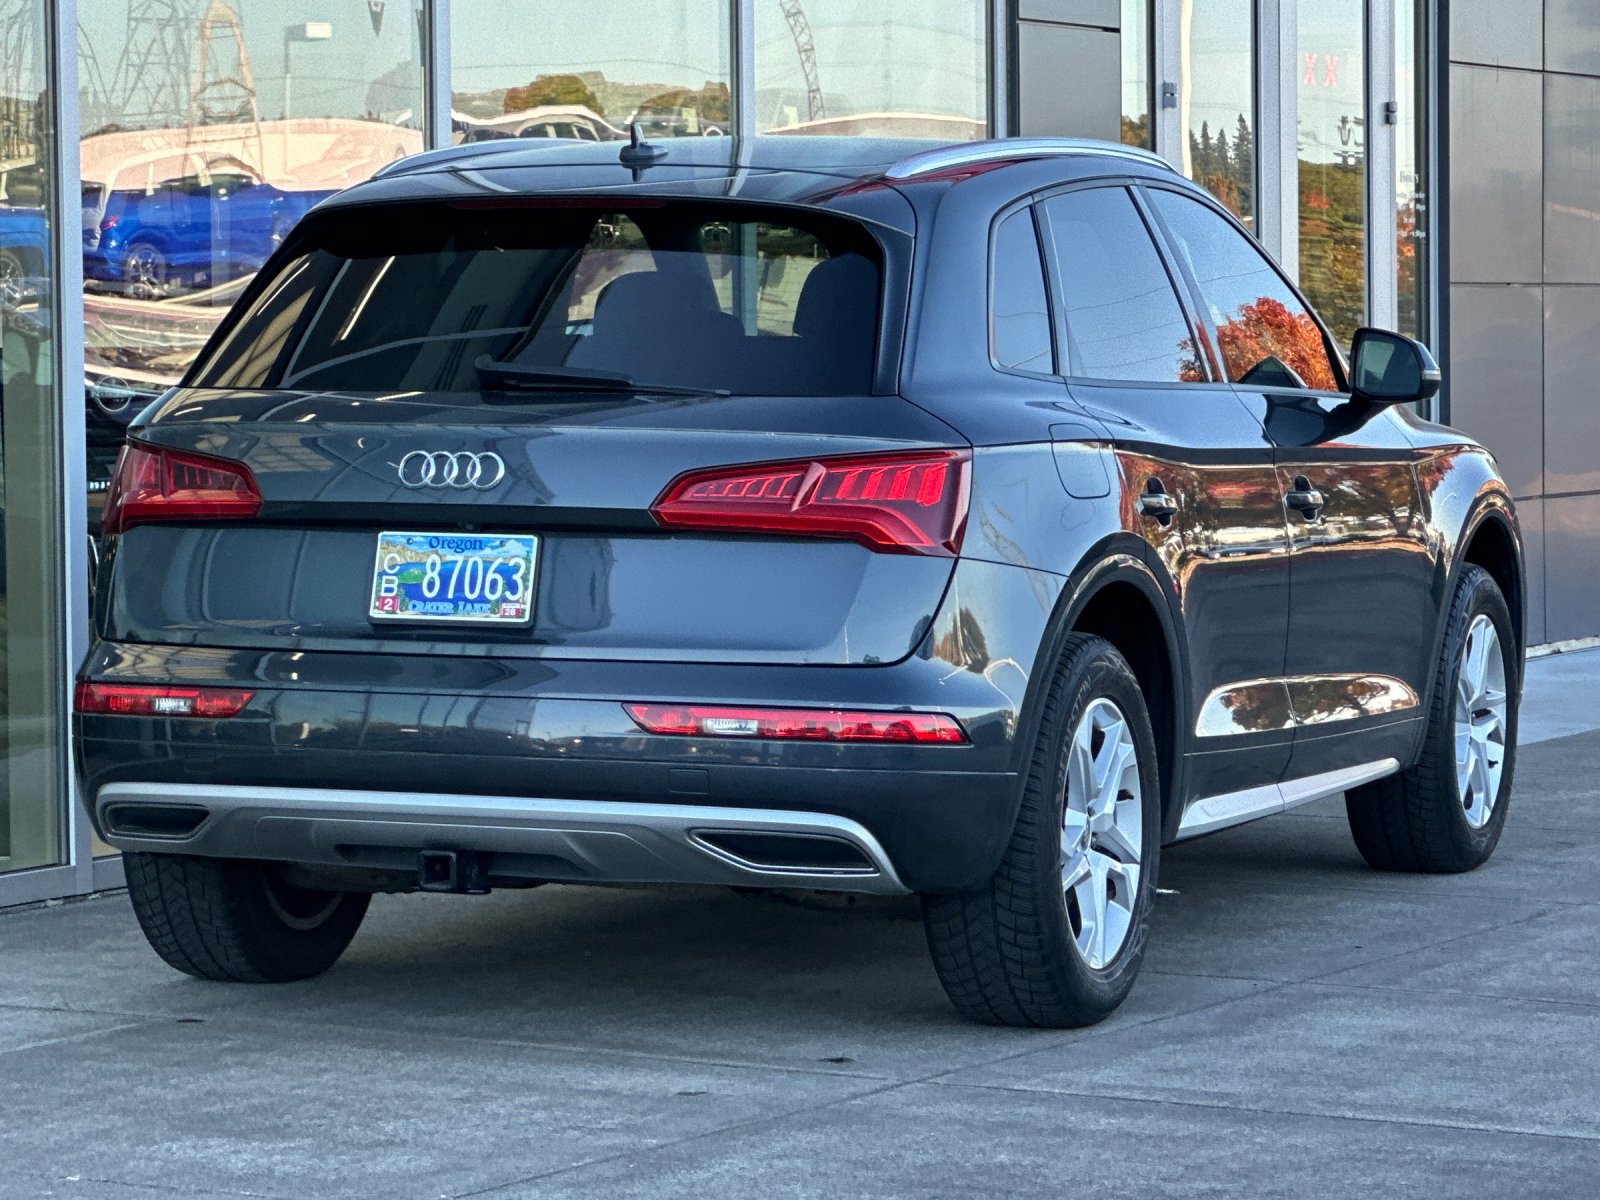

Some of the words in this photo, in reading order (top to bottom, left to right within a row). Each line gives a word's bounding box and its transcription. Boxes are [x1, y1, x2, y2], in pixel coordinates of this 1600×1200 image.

[429, 536, 484, 553] Oregon
[422, 554, 526, 600] 87063
[383, 598, 393, 611] 2
